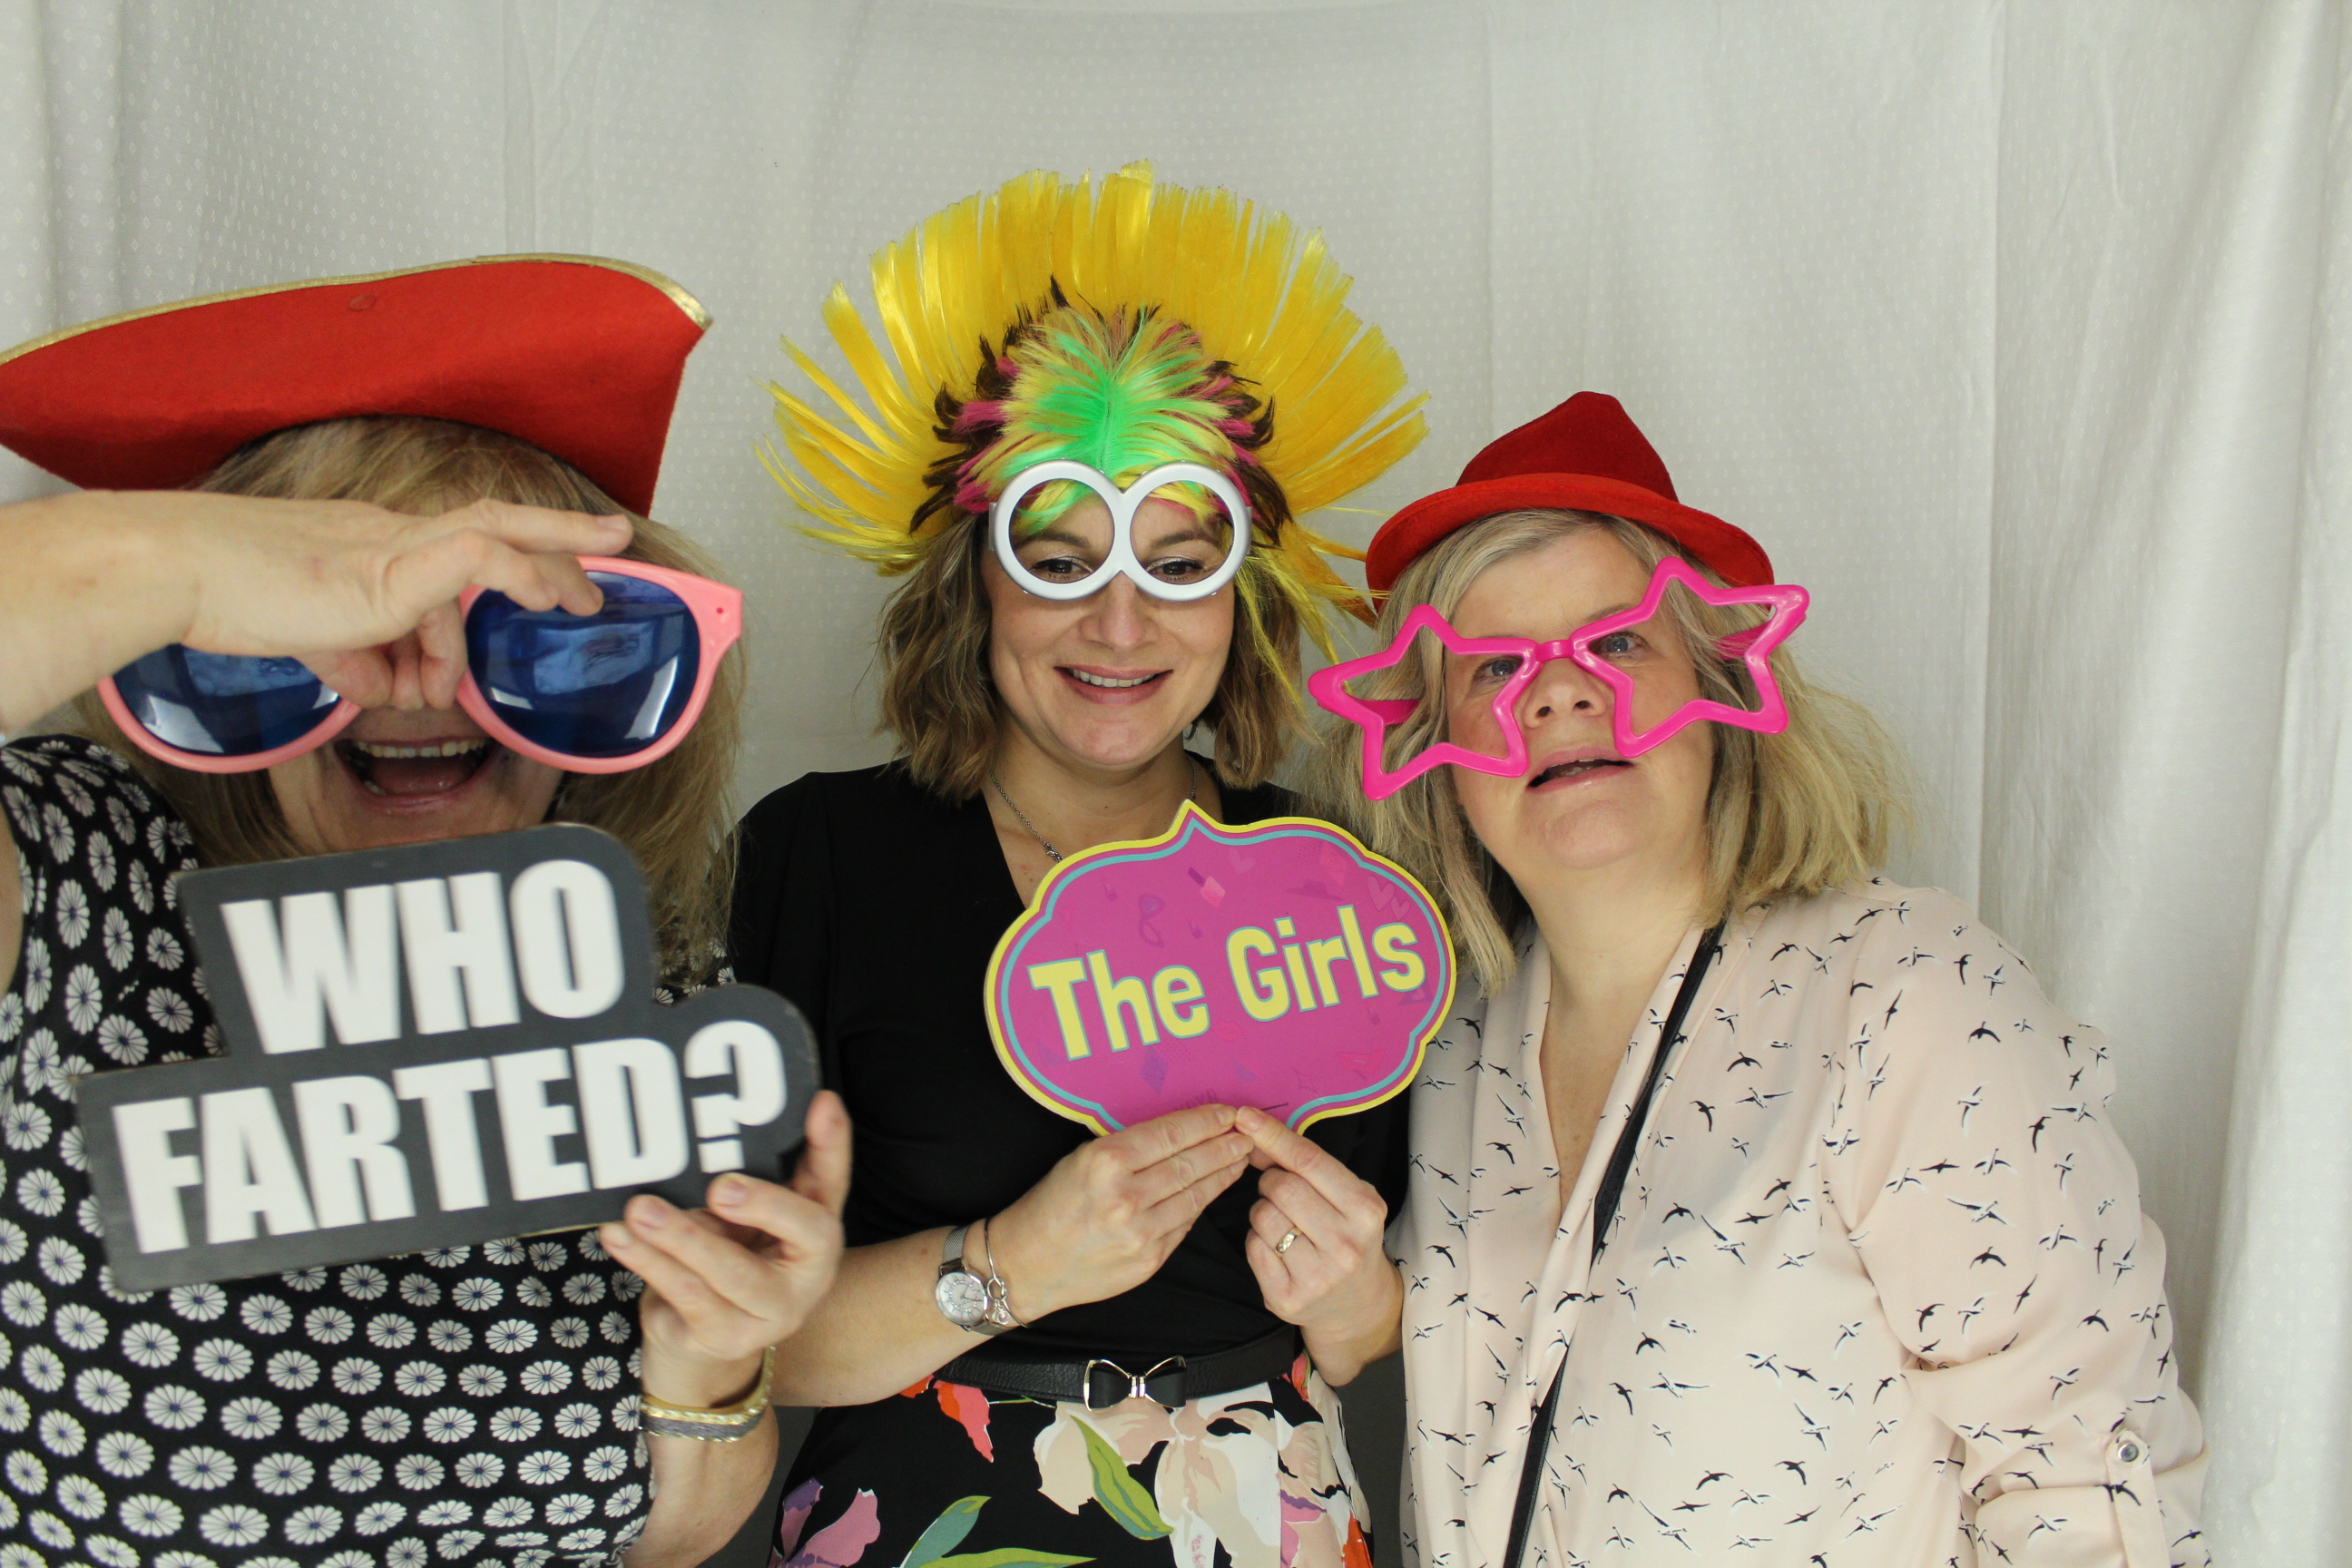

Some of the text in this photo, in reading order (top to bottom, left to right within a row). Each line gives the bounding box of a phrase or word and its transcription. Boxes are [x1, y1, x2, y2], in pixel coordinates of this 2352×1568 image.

[221, 858, 624, 1055] WHO
[1027, 904, 1426, 1062] The Girls
[112, 1019, 787, 1254] FARTED?
